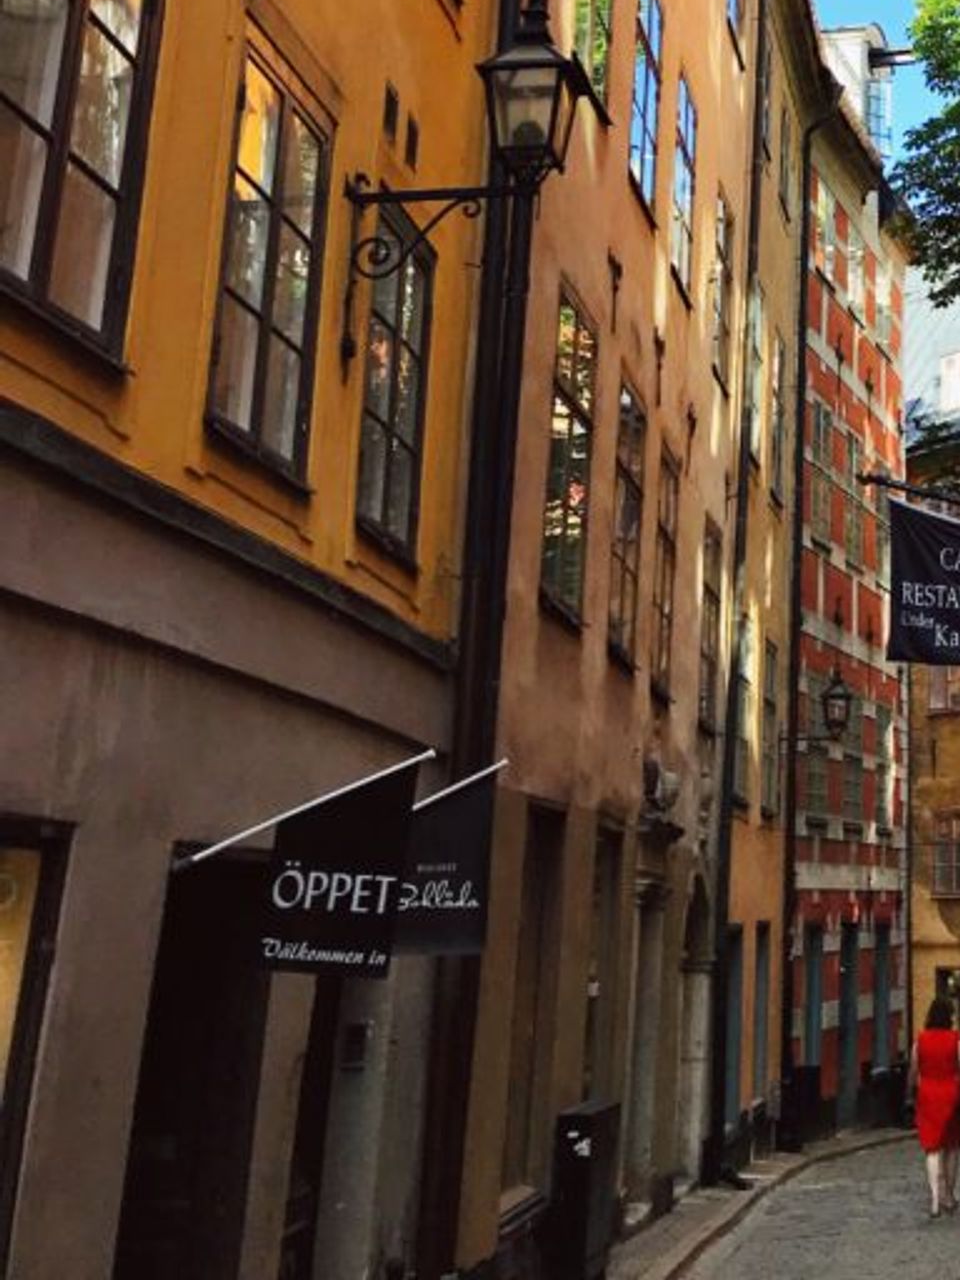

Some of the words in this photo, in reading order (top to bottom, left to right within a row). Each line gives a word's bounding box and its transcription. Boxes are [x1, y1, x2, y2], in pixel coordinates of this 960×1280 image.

[271, 860, 398, 914] ÖPPET
[261, 937, 364, 964] Välkommen
[367, 949, 387, 966] in
